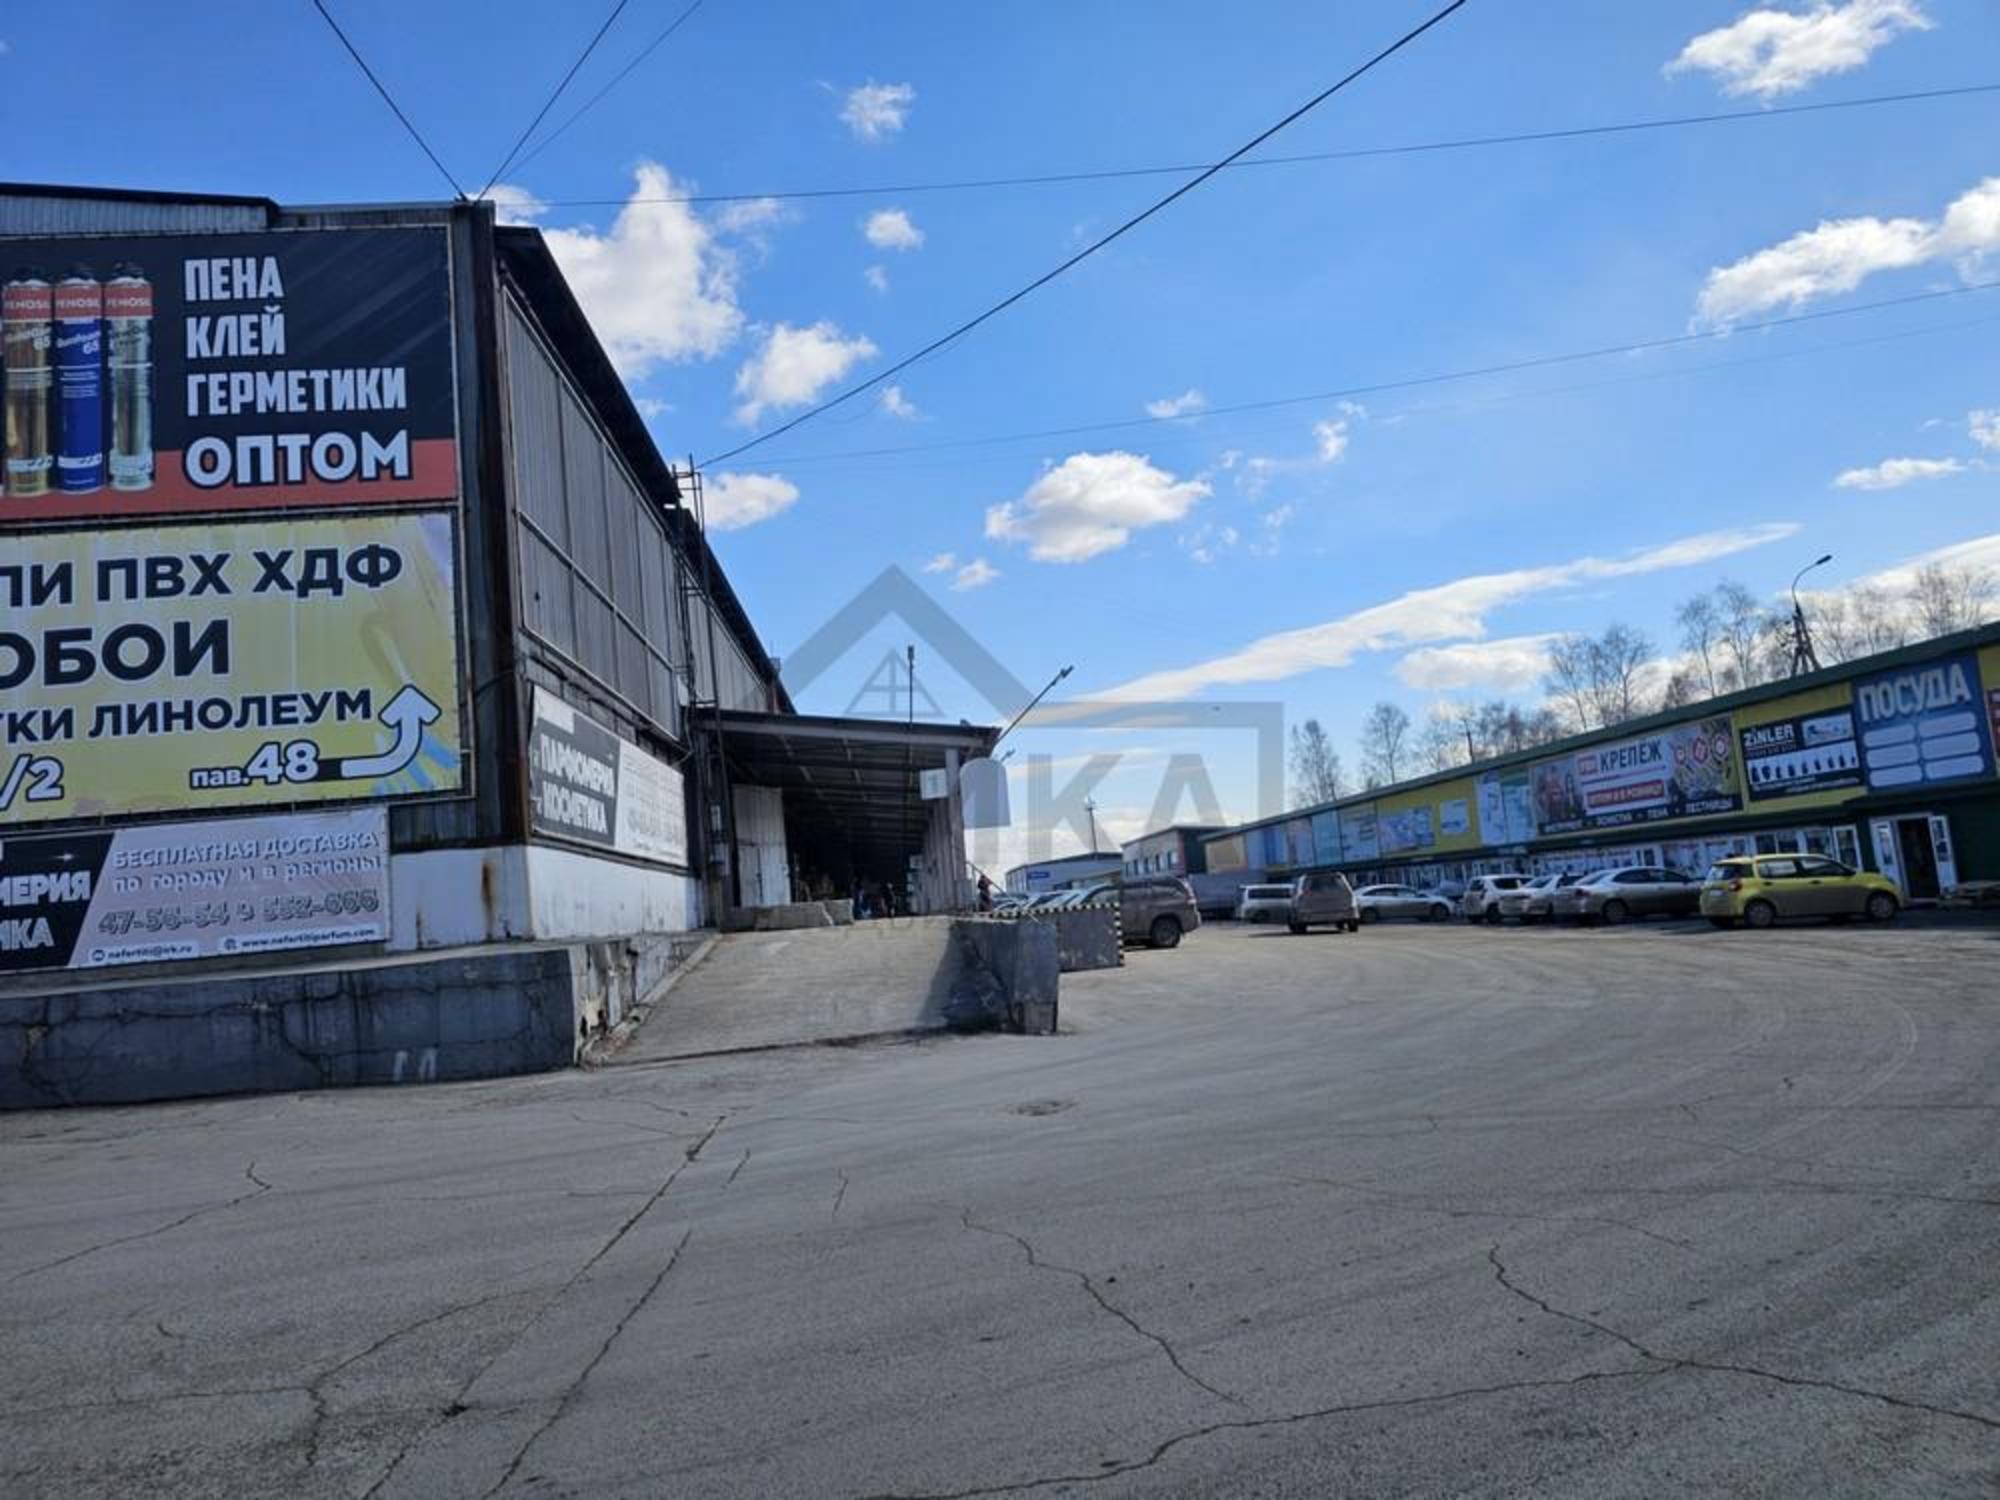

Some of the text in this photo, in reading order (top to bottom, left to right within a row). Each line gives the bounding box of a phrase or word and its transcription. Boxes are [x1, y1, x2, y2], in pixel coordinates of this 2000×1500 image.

[184, 256, 284, 300] ПЕНА
[186, 304, 285, 358] КЛЕЙ
[187, 367, 407, 416] ГЕРМЕТИКИ
[185, 430, 410, 486] ОПТОМ
[96, 553, 231, 602] ПВХ
[253, 544, 403, 599] ХДФ
[0, 688, 372, 744] КИ ЛИНОЛЕУМ
[1858, 663, 1972, 723] ПОСУДА
[1600, 739, 1662, 772] КРЕПЕЖ
[112, 830, 380, 869] БЕСПЛАТНАЯ ДОСТАВКА
[112, 875, 143, 894] по
[150, 867, 232, 894] городу
[285, 854, 382, 882] регионы
